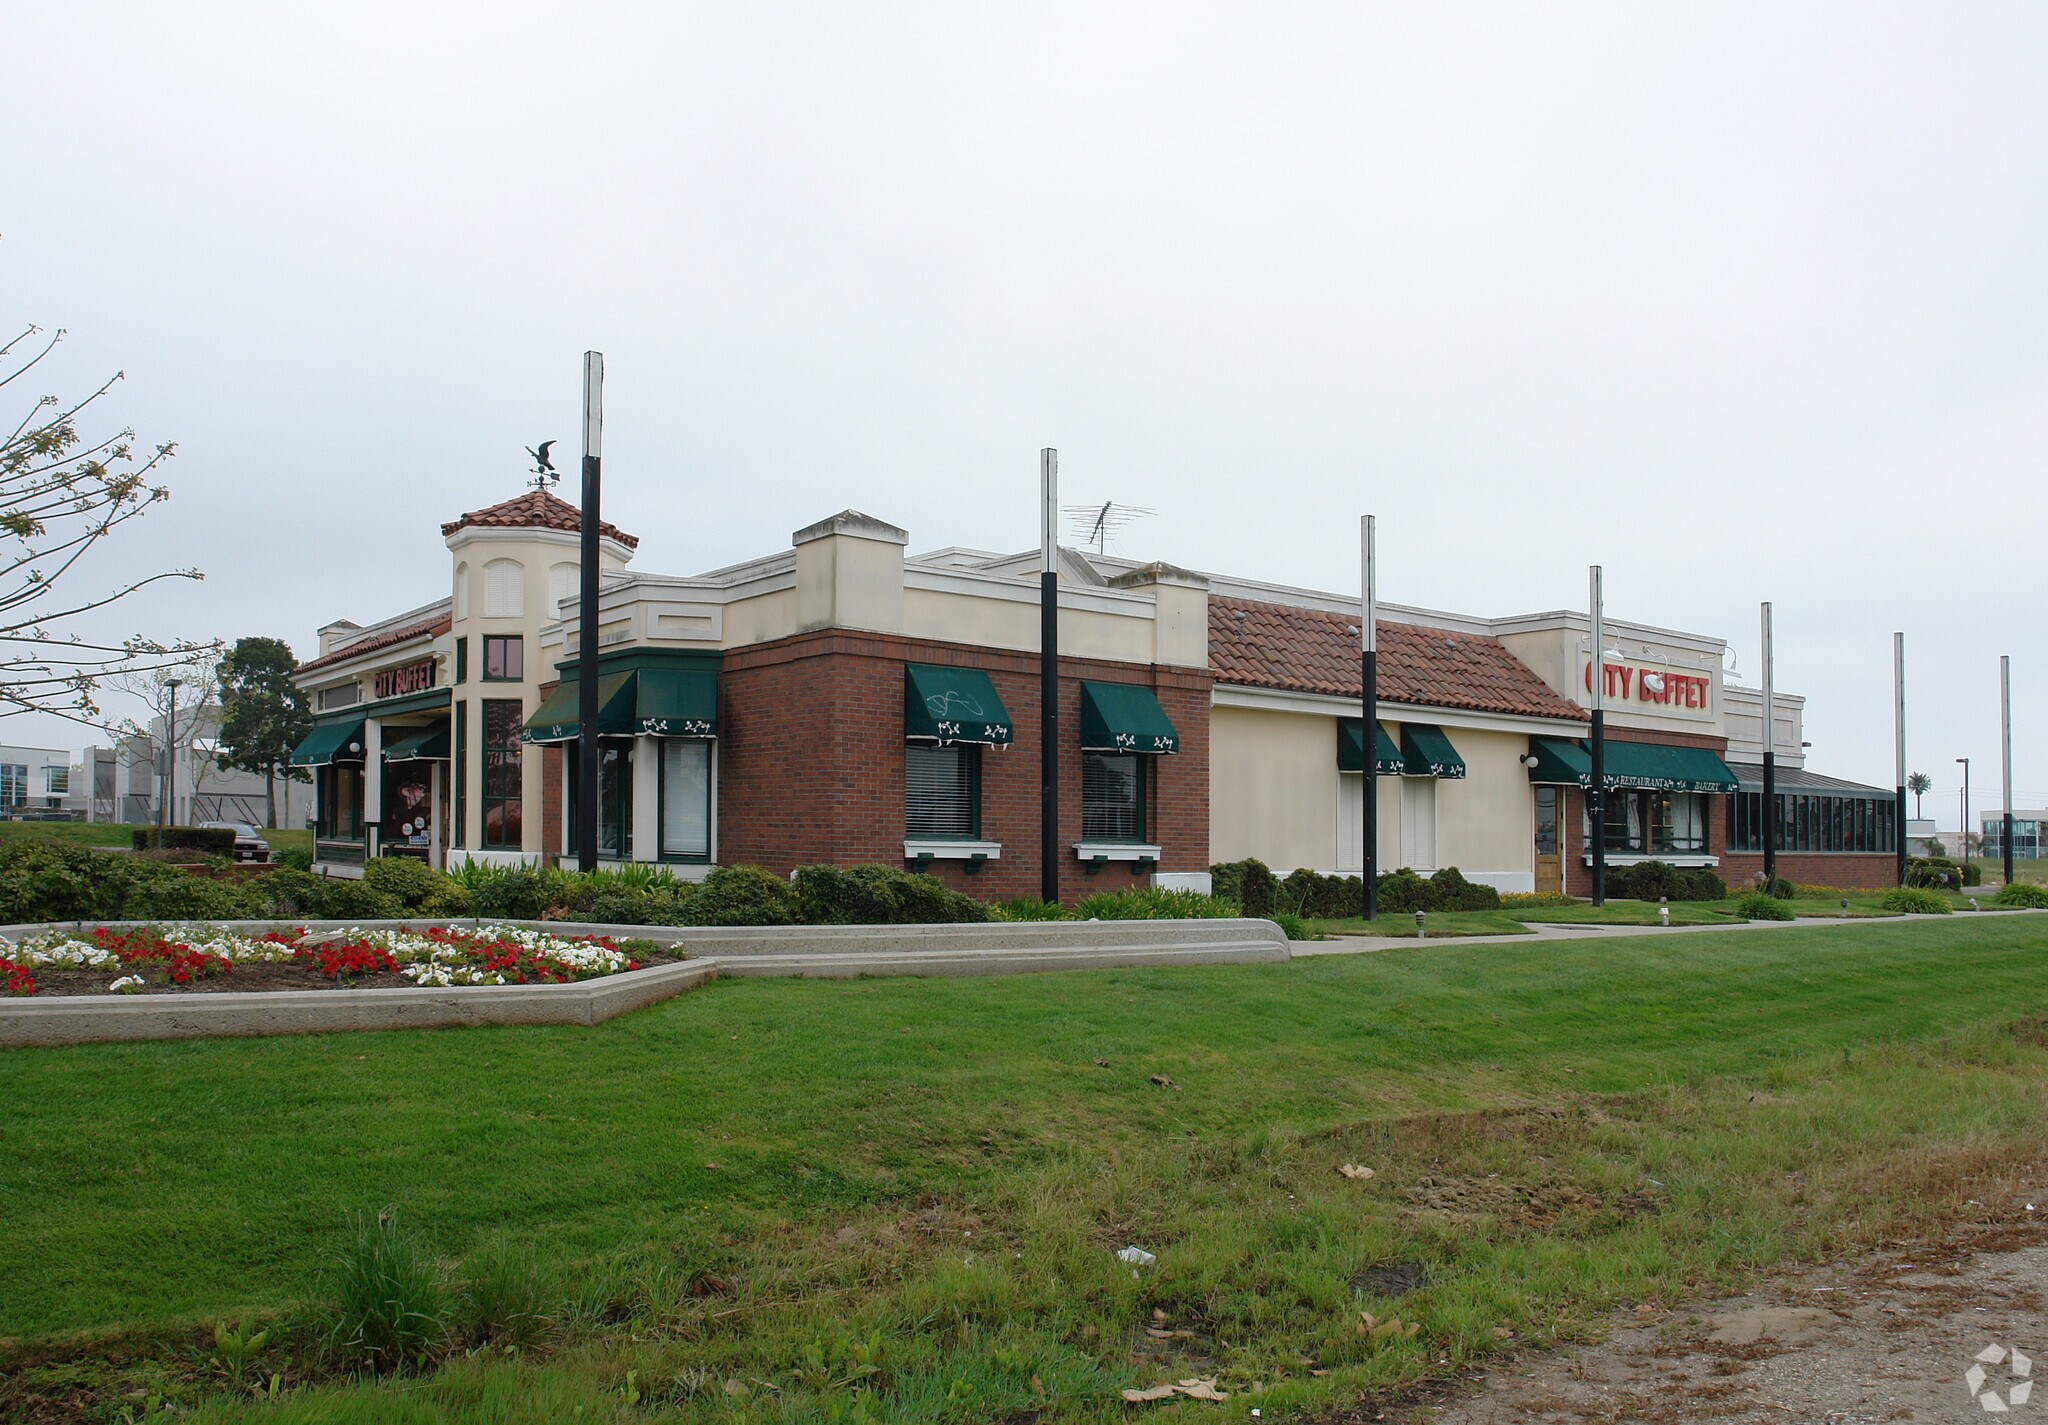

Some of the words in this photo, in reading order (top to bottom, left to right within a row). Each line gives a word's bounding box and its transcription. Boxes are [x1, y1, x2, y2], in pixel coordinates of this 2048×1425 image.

[395, 661, 432, 695] BUFFET
[1620, 775, 1664, 787] RESTAURANT
[1694, 781, 1720, 791] BAKERY
